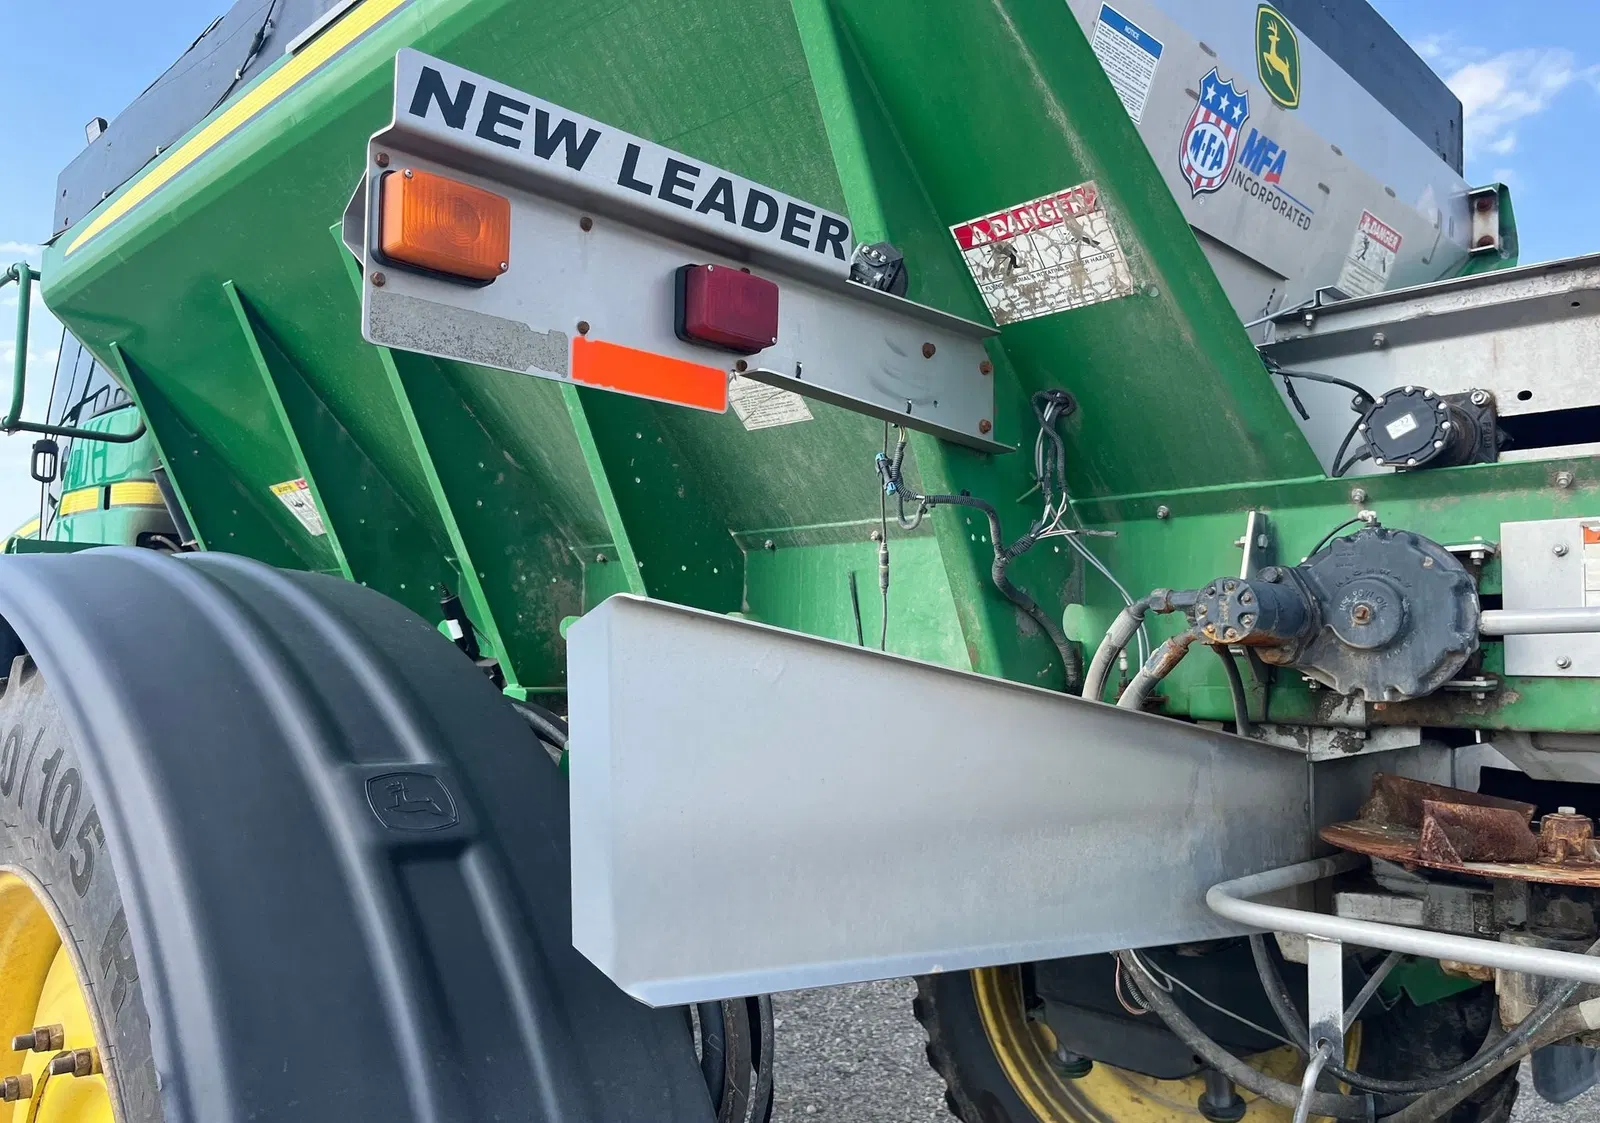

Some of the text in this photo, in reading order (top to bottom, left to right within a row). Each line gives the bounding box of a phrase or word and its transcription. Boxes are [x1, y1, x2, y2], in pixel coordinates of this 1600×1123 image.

[408, 65, 850, 261] NEW LEADER
[1231, 168, 1312, 231] INCORPORATED
[1238, 127, 1287, 184] MFA
[0, 723, 106, 898] 0/105
